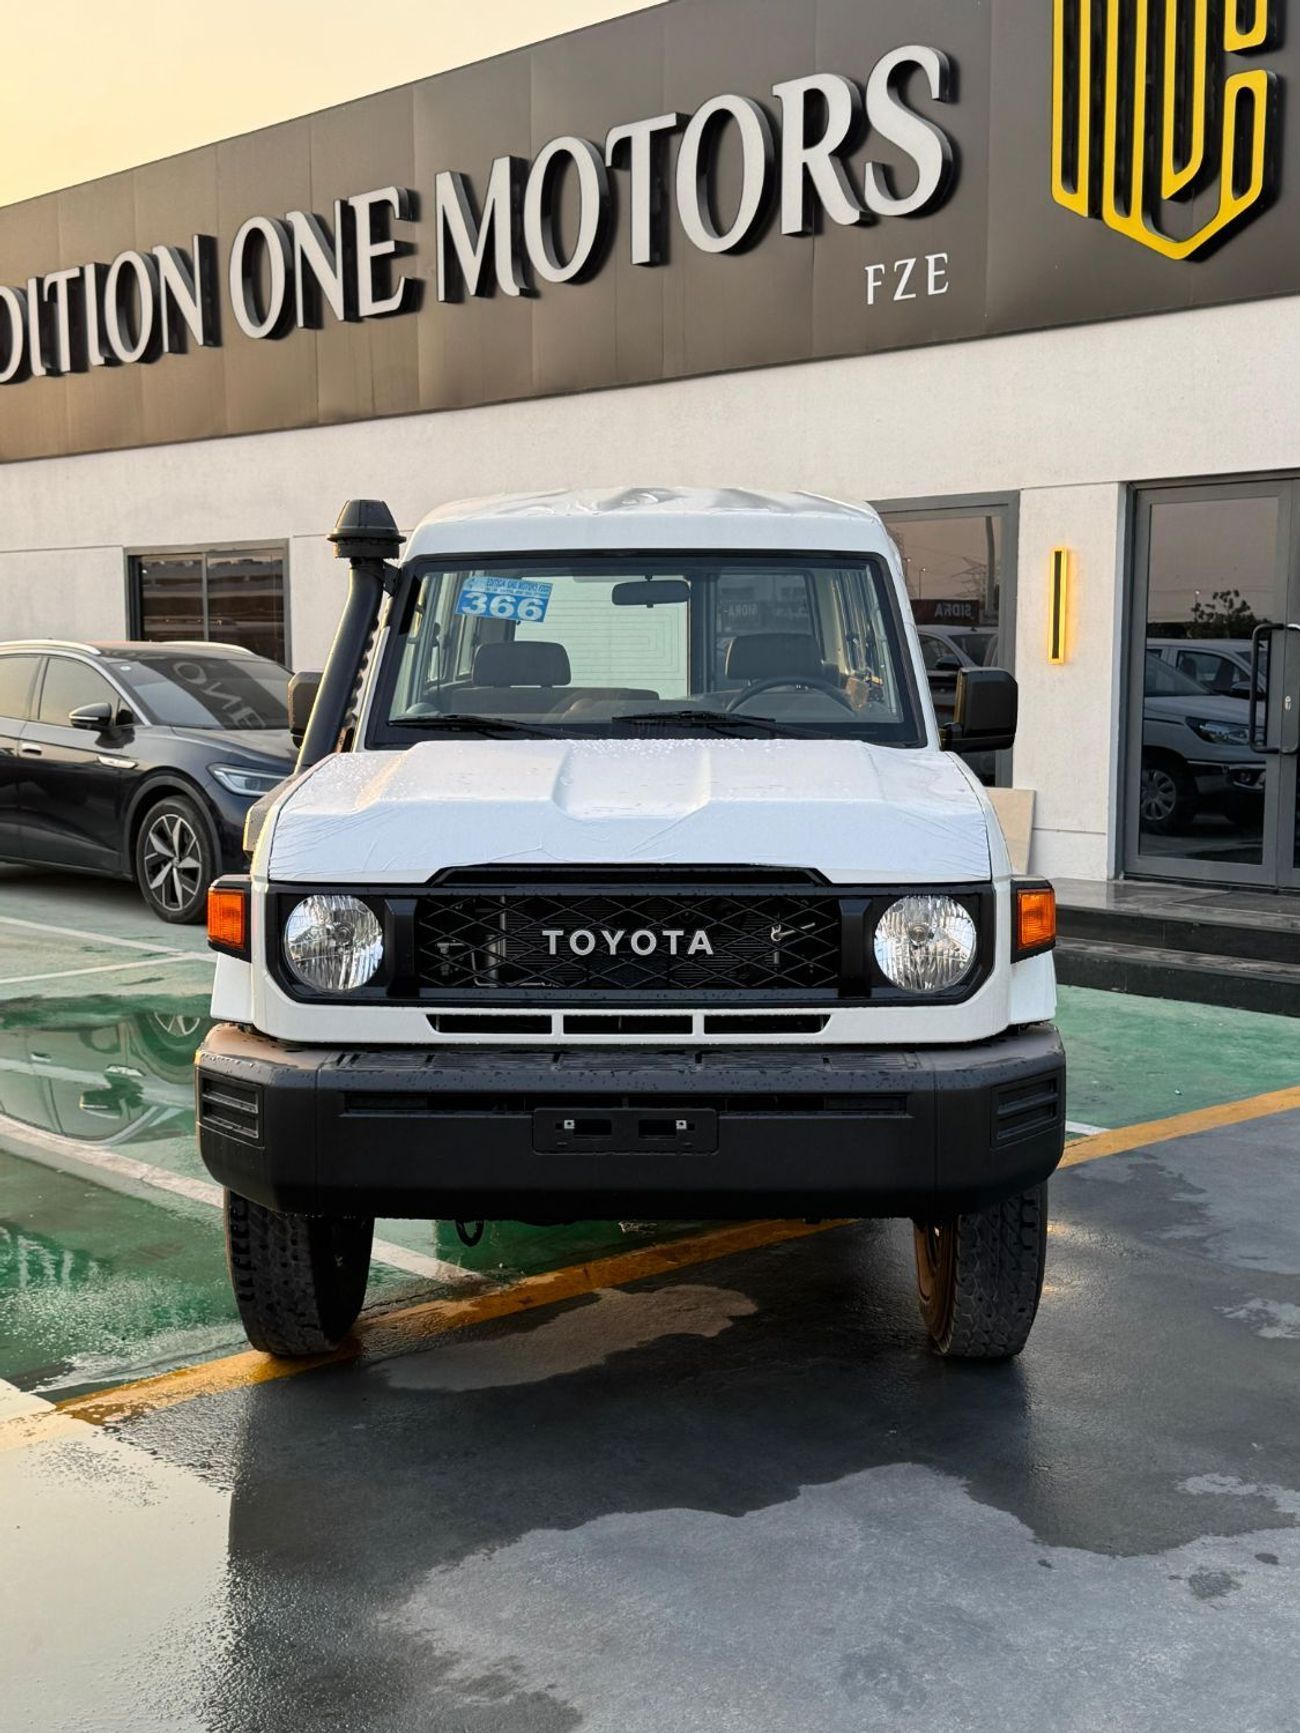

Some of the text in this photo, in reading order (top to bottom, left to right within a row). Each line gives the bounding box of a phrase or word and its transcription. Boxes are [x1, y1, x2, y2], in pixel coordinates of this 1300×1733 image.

[229, 186, 412, 339] ONE
[436, 45, 952, 302] MOTORS
[864, 252, 949, 304] FZE
[462, 592, 544, 621] 366
[542, 929, 714, 956] TOYOTA
